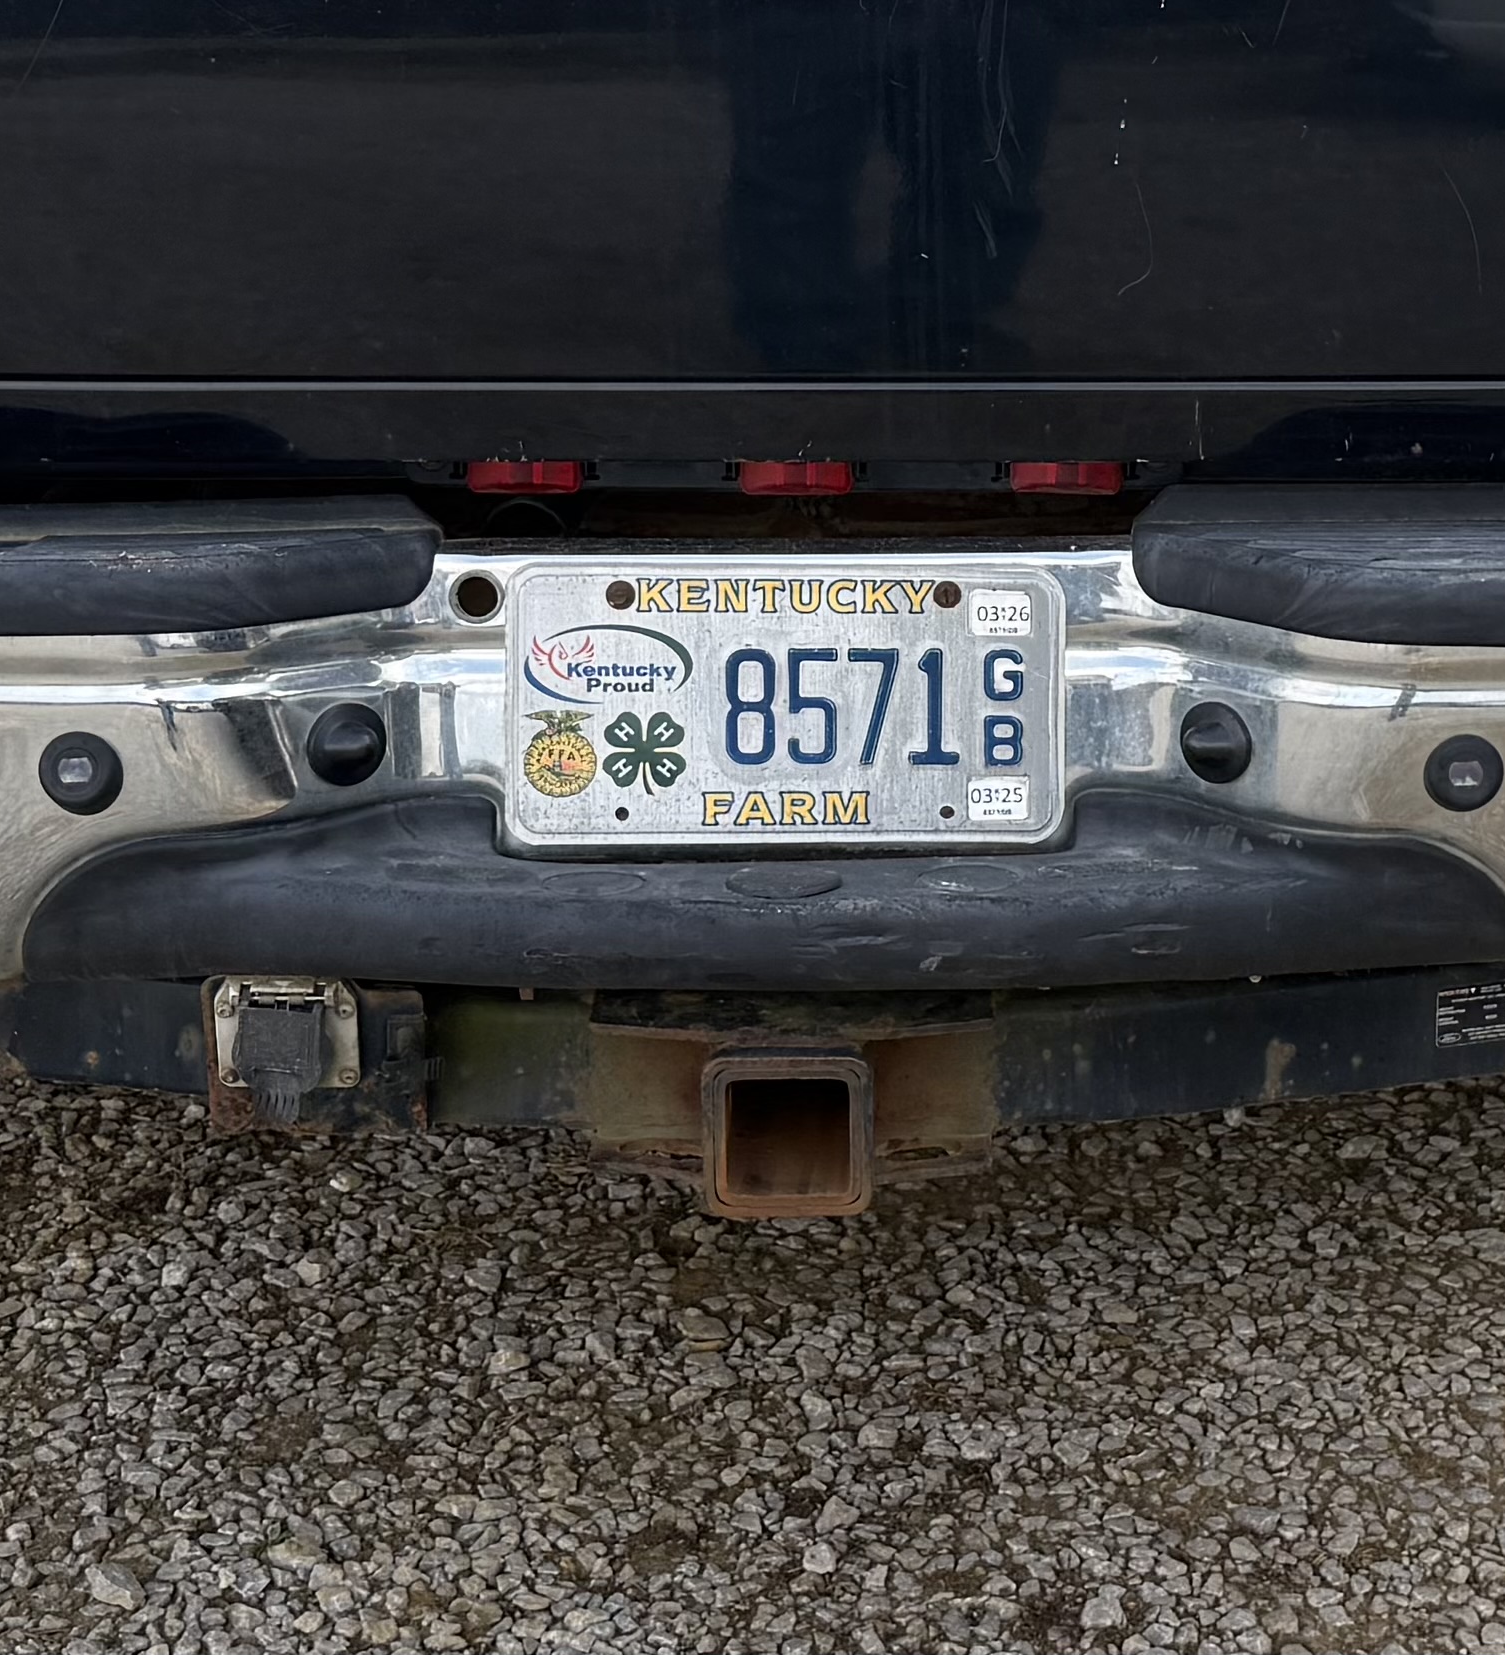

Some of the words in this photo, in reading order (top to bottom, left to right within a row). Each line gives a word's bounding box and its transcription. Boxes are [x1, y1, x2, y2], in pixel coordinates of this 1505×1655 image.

[635, 578, 936, 614] KENTUCKY
[567, 662, 677, 681] Kentucky
[586, 677, 655, 693] Proud
[724, 647, 960, 766] 8571
[701, 790, 871, 826] FARM
